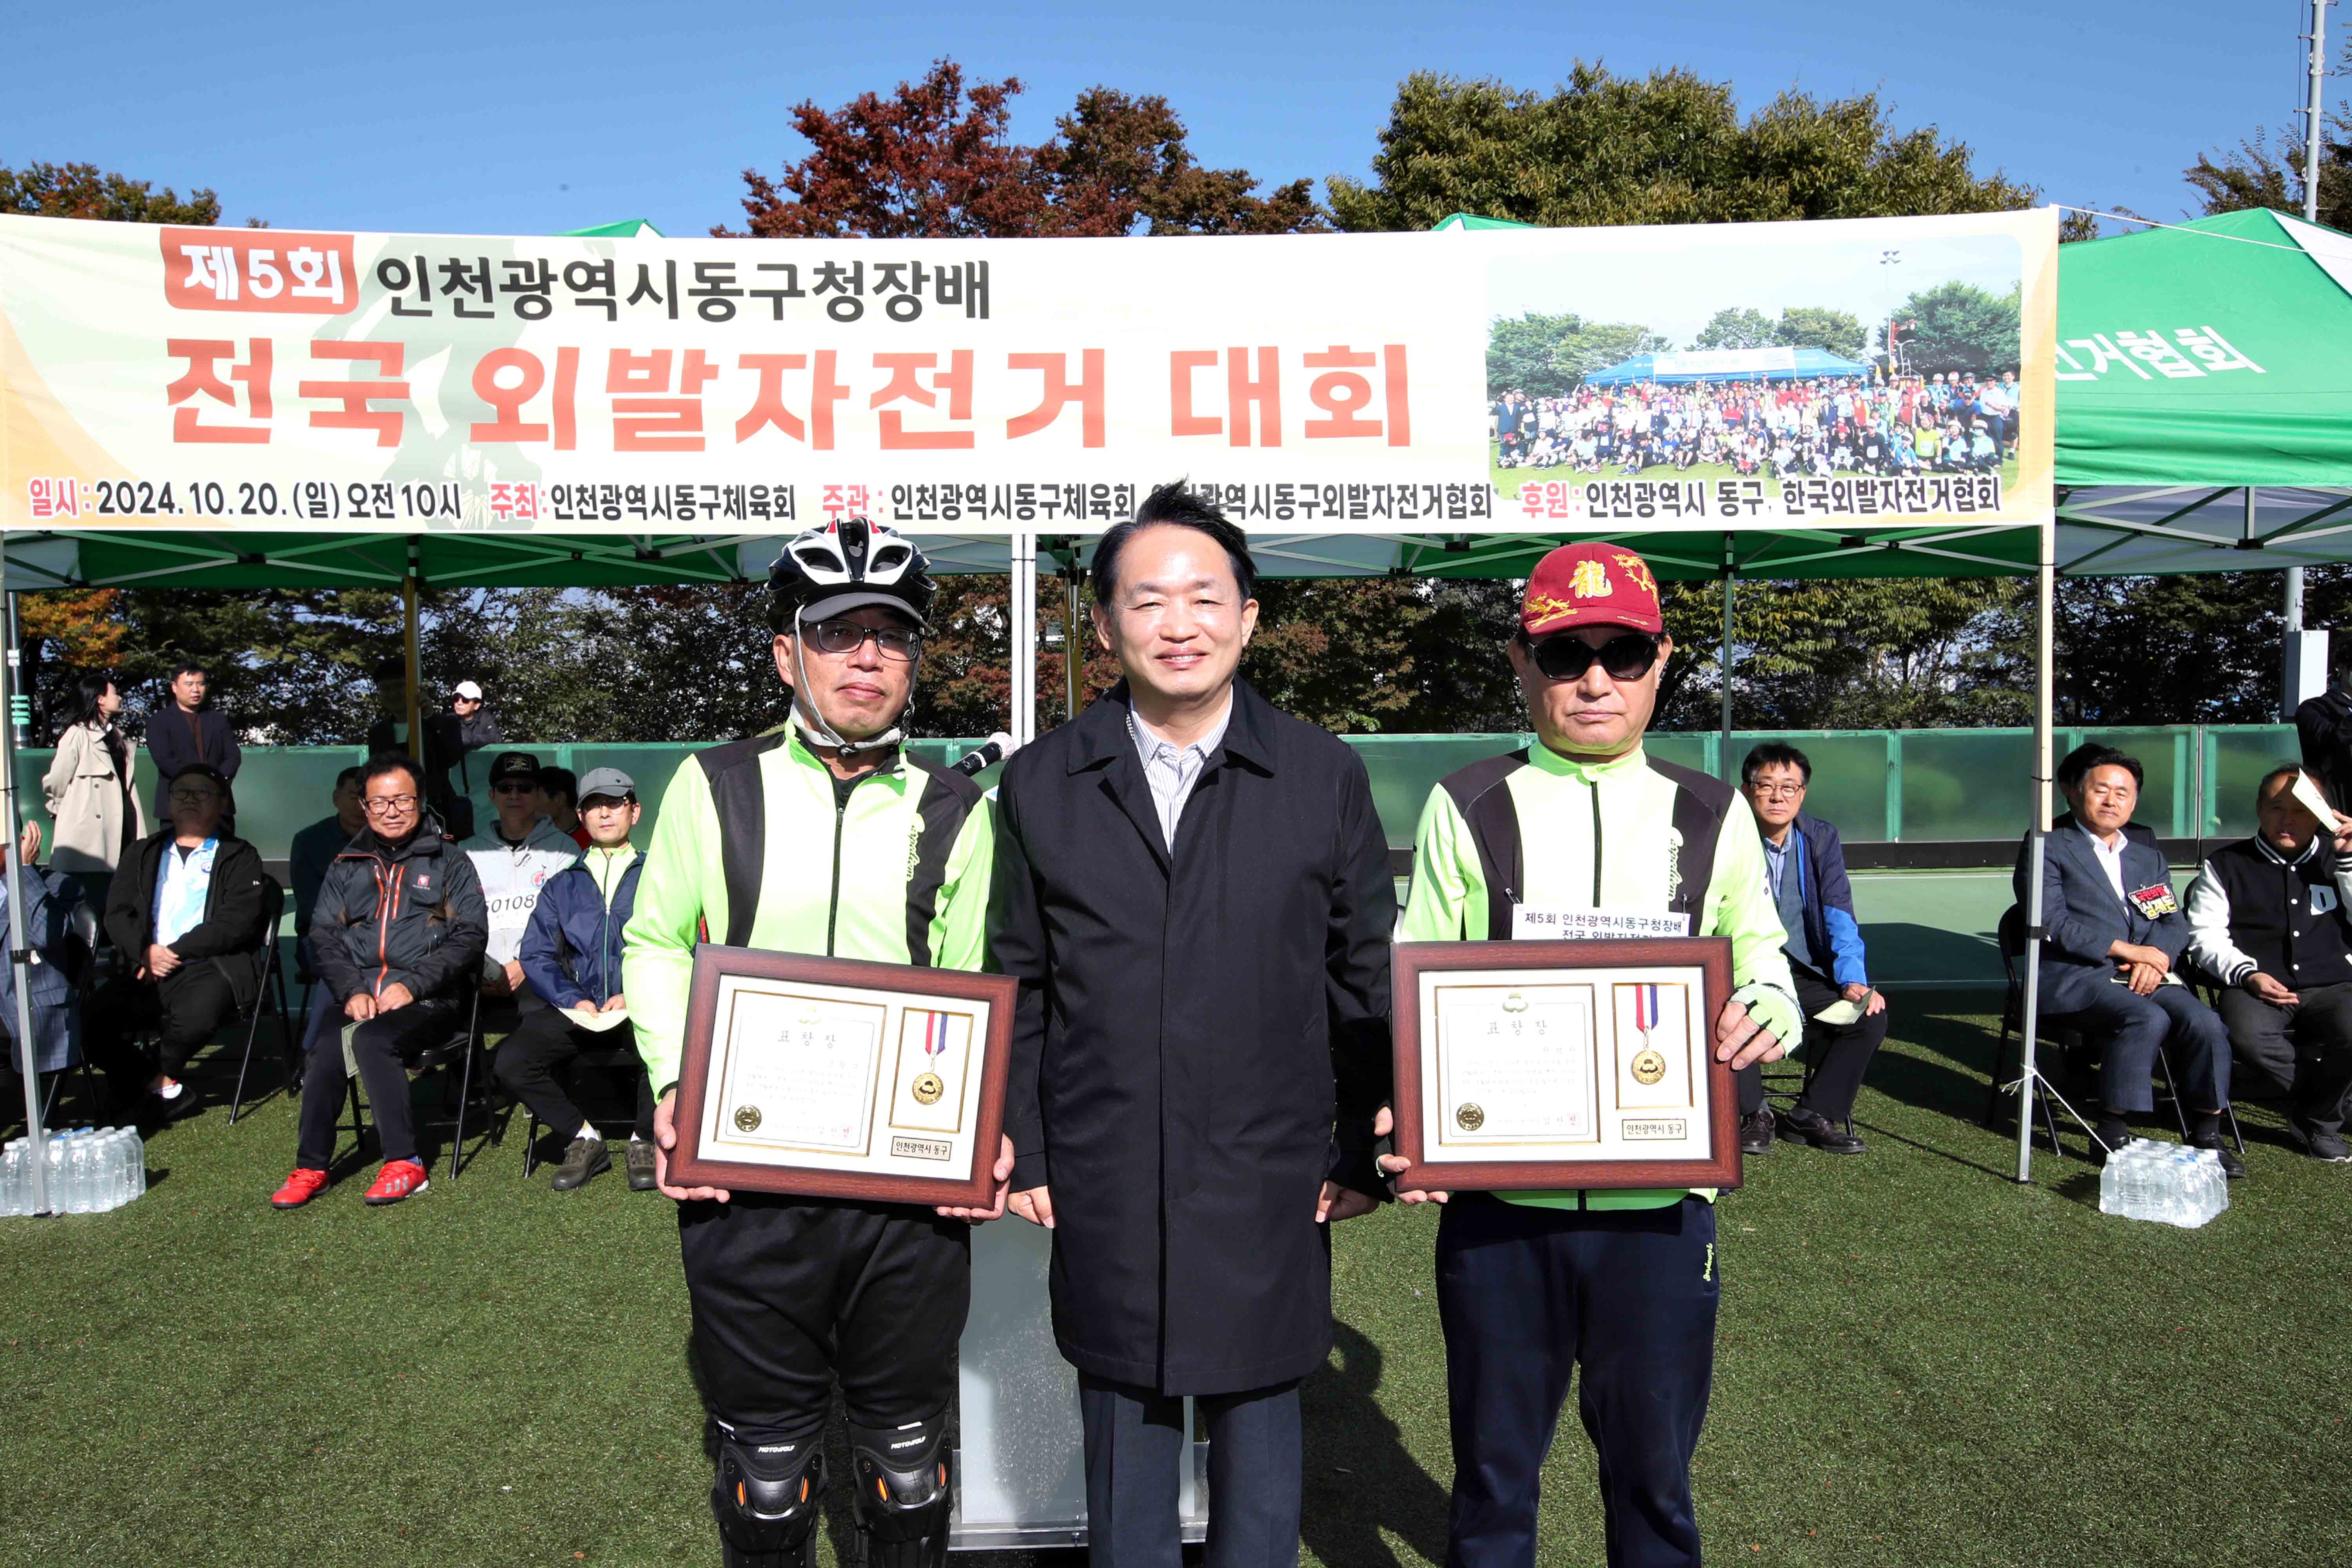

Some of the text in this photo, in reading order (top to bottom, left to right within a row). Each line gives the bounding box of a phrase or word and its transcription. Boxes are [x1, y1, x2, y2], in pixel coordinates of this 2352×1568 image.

[180, 245, 989, 322] 제5회 인천광역시동구청장배
[166, 338, 1410, 452] 전국 외발자전거 대회
[551, 485, 795, 521] 인천광역시동구체육회
[892, 484, 1135, 520] 인천광역시동구체육회
[1586, 481, 1705, 517] 인천광역시
[1783, 477, 2001, 515] 한국외발자전거협회
[1569, 560, 1613, 599] 龍
[1525, 913, 1682, 933] 제5회 인천광역시동구청장배
[896, 1141, 947, 1155] 인천광역시 동구
[1627, 1124, 1682, 1134] 인천광역시 동구
